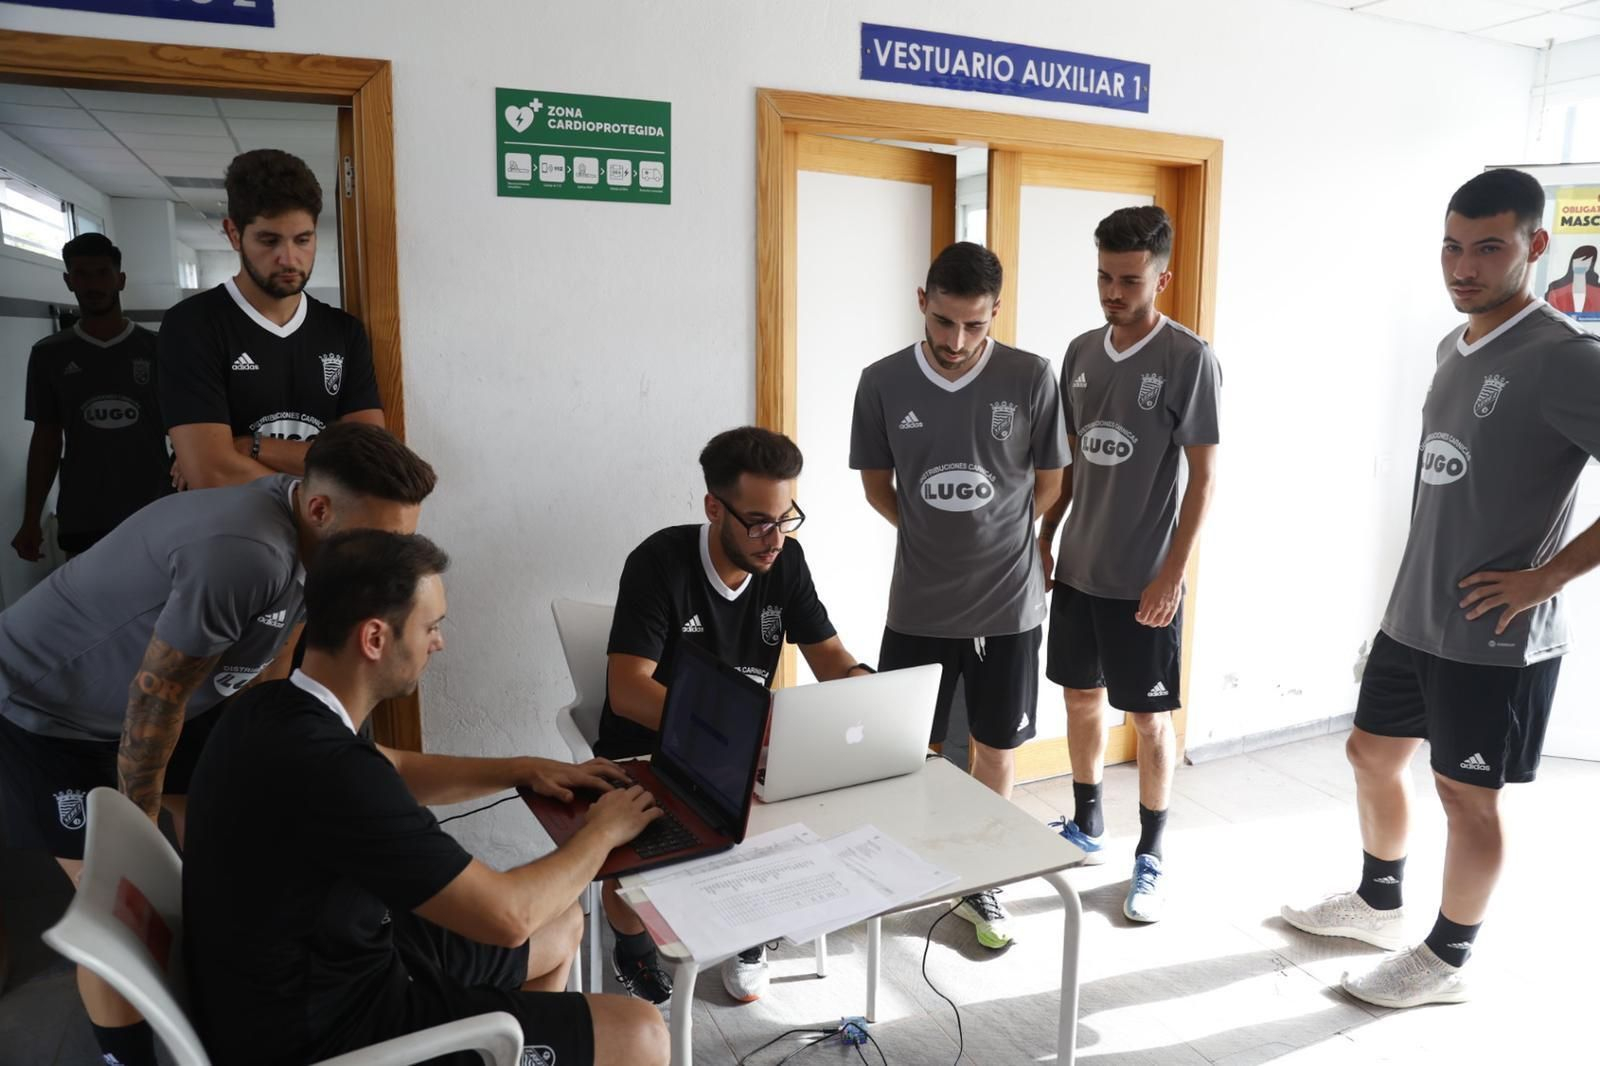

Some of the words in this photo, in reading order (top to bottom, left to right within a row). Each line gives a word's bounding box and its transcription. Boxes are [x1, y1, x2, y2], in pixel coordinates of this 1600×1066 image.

[873, 38, 1014, 82] VESTUARIO
[1022, 59, 1125, 98] AUXILIAR
[1133, 75, 1141, 100] 1
[547, 105, 583, 118] ZONA
[547, 119, 664, 137] CARDIOPROTEGIDA
[1560, 216, 1600, 227] MASC
[1082, 435, 1131, 458] LUGO
[1424, 452, 1464, 477] UGO
[924, 483, 992, 500] LUGO
[1459, 762, 1491, 772] adidas
